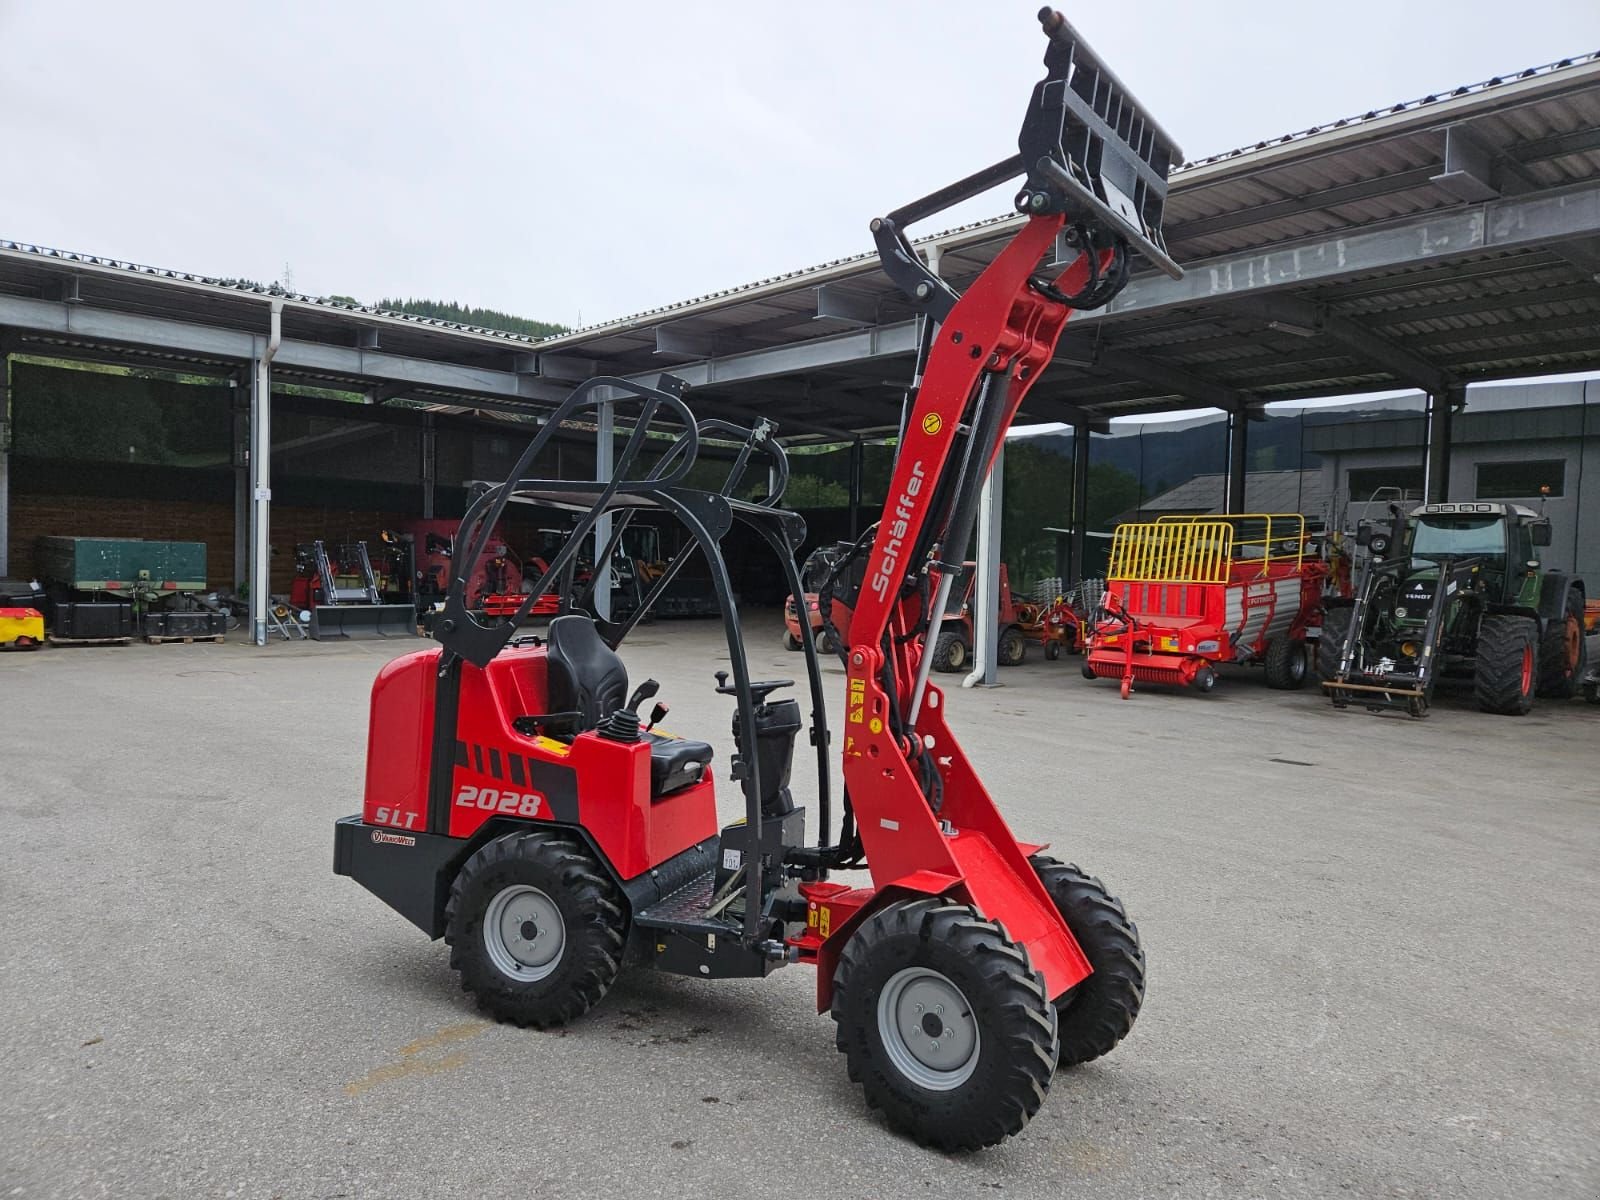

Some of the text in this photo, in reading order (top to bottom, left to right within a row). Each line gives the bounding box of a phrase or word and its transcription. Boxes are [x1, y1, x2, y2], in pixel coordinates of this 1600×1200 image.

[872, 461, 925, 602] Schäffer
[456, 785, 541, 816] 2028
[374, 806, 418, 829] SLT
